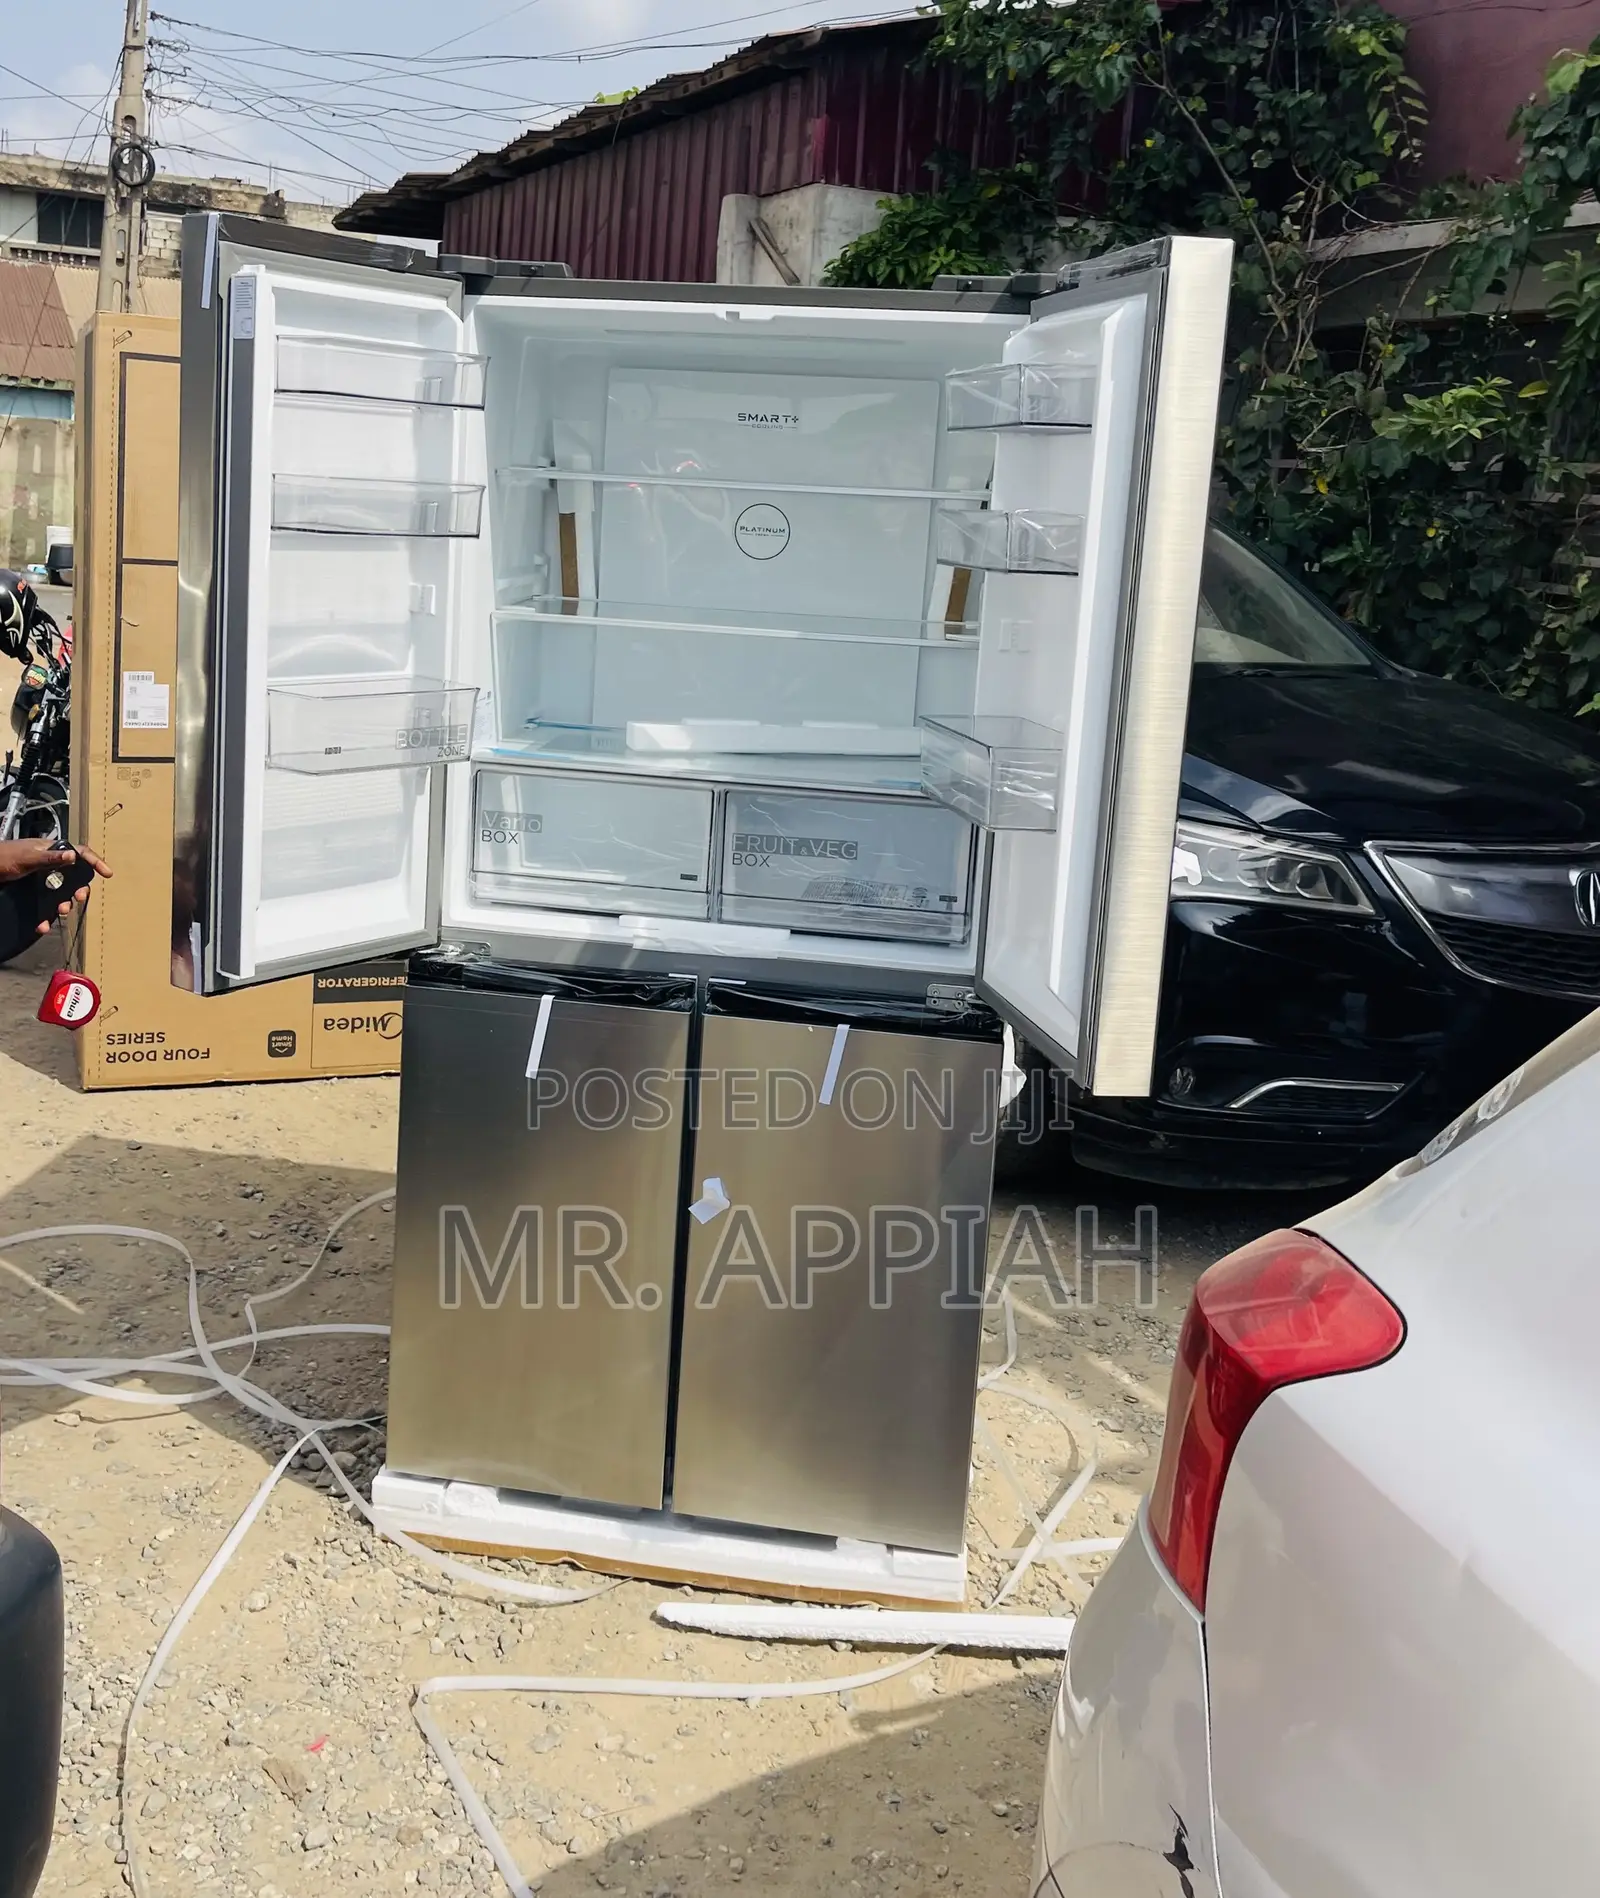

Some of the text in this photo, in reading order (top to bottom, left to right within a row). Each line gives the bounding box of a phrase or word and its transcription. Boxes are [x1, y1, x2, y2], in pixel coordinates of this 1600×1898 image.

[740, 526, 786, 534] PLATINUM
[397, 725, 467, 748] BOTTLE
[437, 745, 466, 757] ZONE
[483, 811, 541, 832] Vario
[481, 829, 519, 845] BOX
[732, 852, 771, 868] BOX
[323, 1014, 401, 1036] Midea
[106, 1031, 166, 1046] SERIES
[105, 1048, 210, 1064] FOUR DOOR
